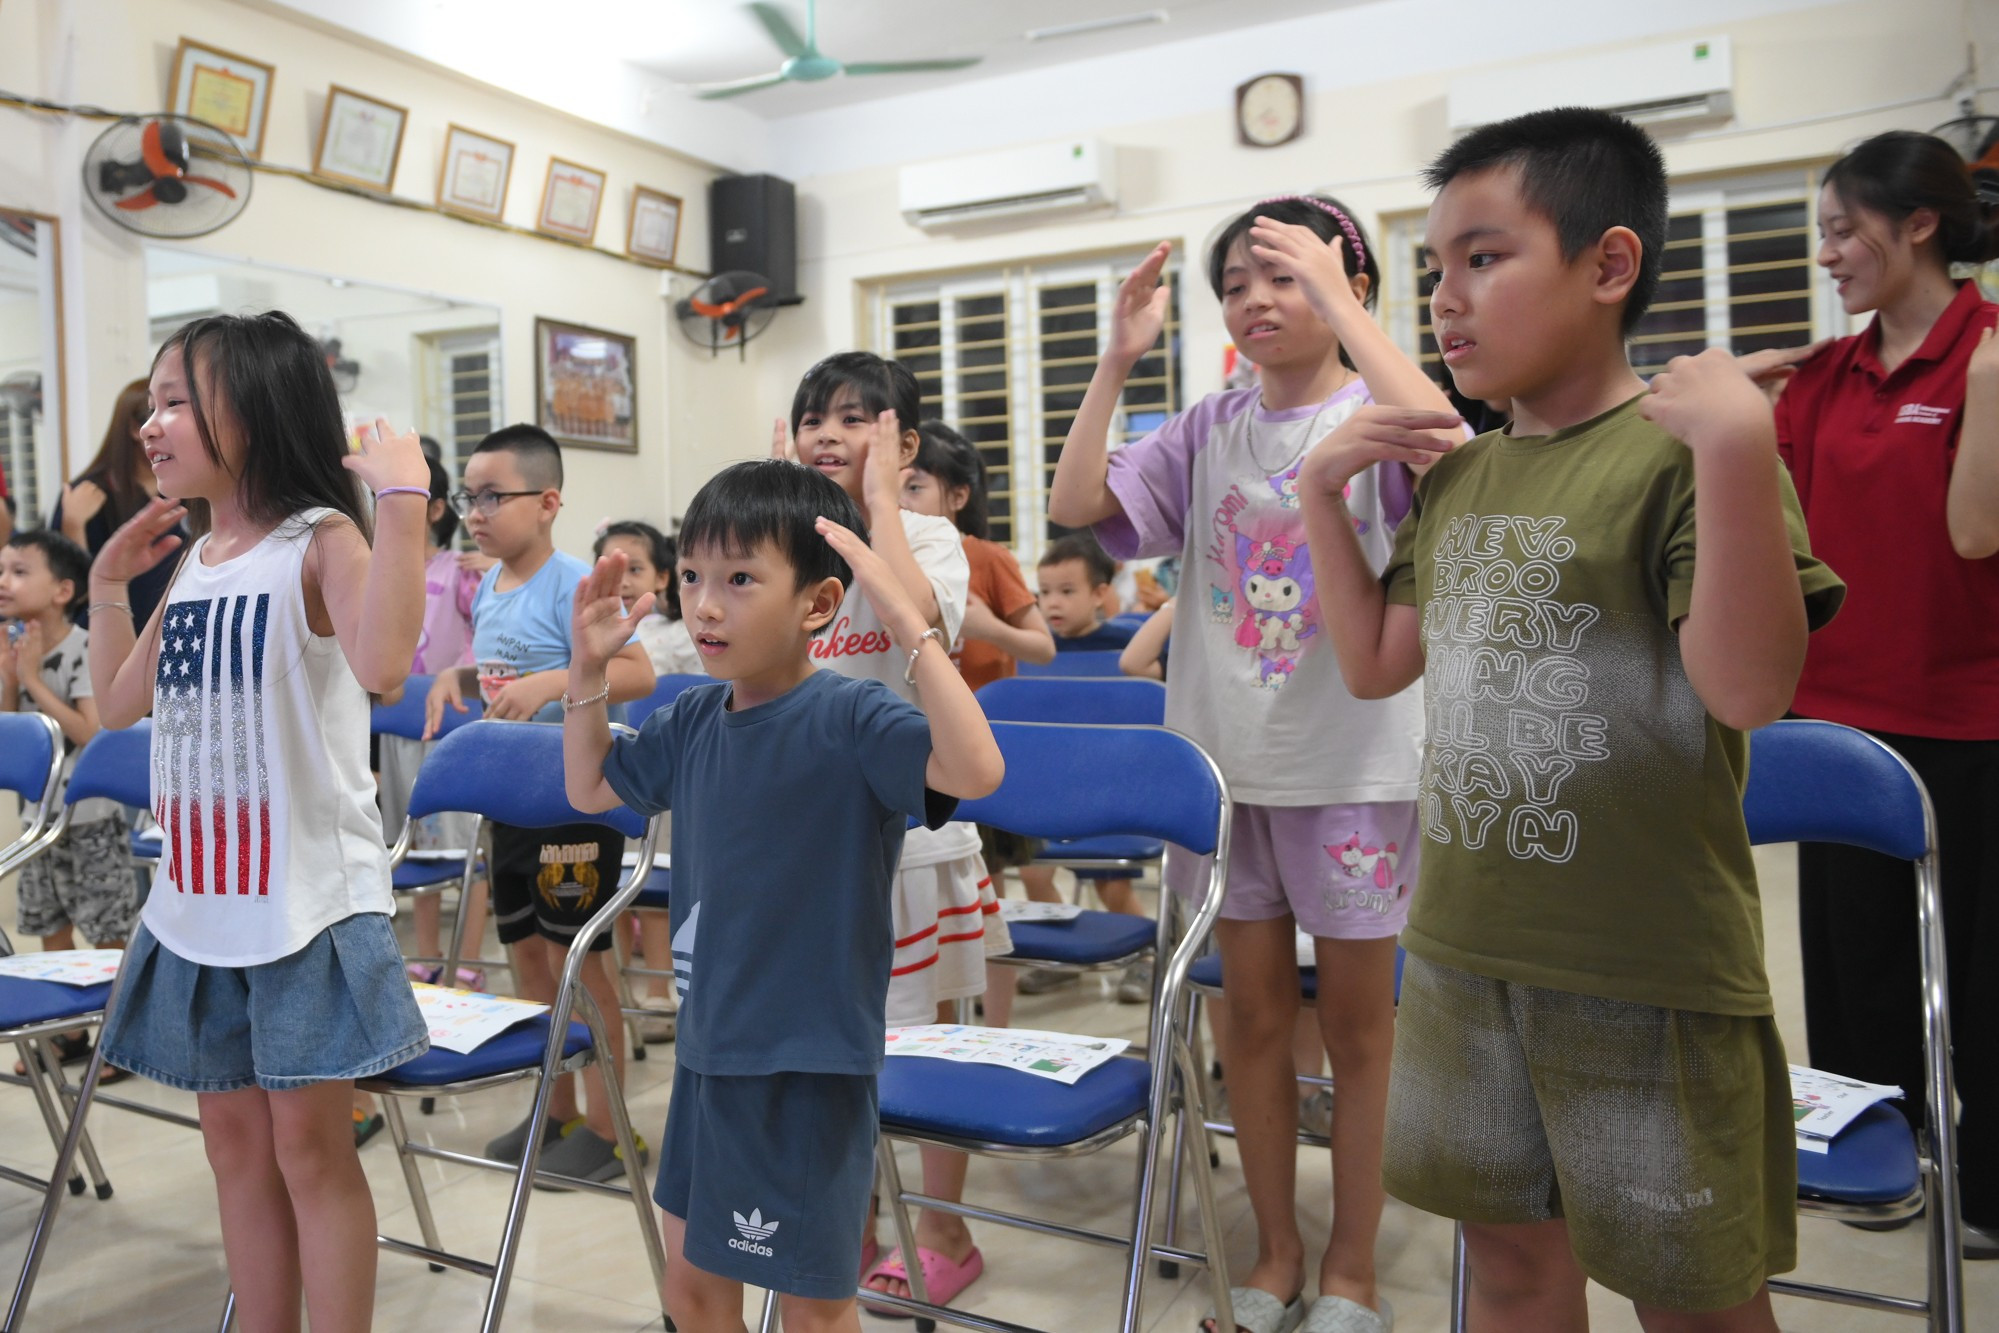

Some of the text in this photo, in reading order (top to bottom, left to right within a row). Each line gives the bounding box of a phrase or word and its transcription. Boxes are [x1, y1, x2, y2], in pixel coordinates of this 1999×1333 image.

[1433, 559, 1560, 599] BROO
[1507, 709, 1610, 761] BE
[728, 1238, 774, 1257] adidas
